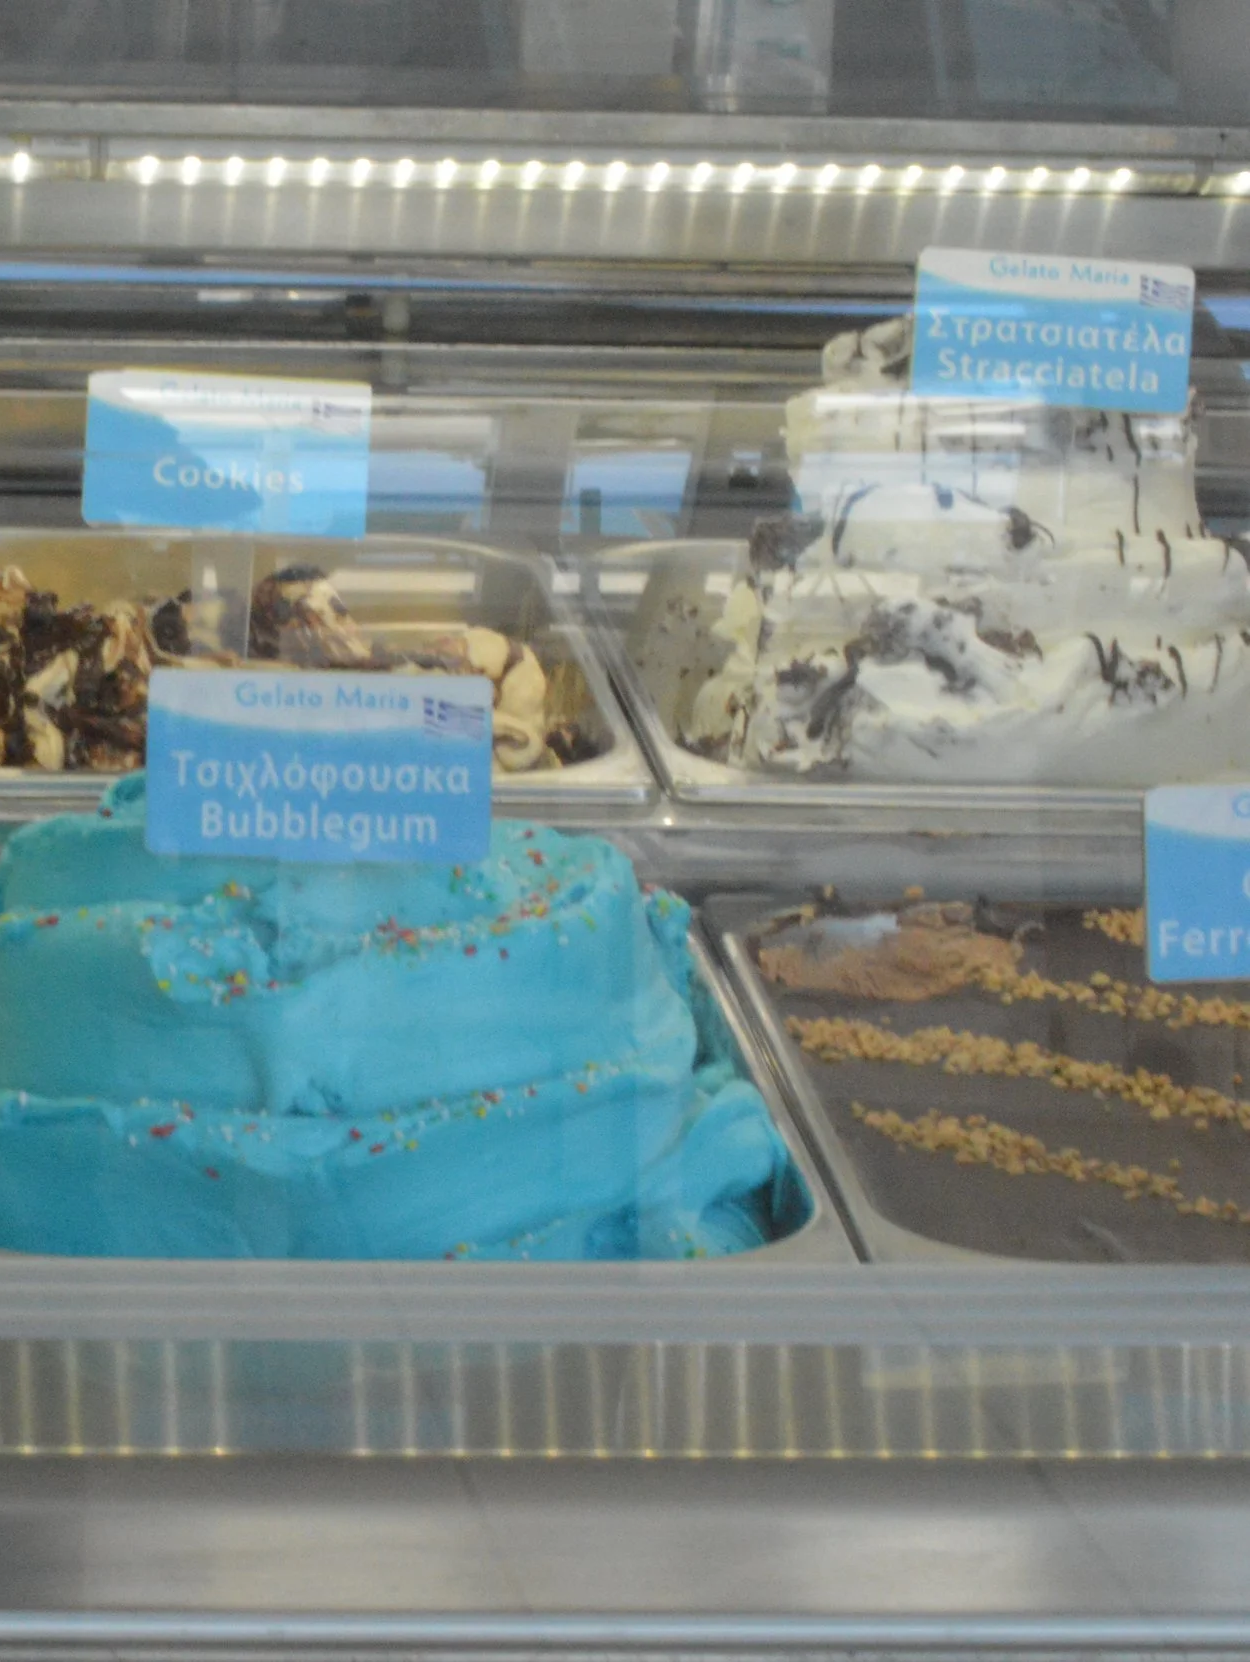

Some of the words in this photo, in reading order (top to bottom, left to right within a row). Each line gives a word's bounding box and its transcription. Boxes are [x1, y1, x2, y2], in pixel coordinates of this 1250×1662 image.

[989, 256, 1061, 281] Gelato
[1069, 265, 1131, 286] Maria
[927, 308, 1187, 356] Στρατσιατέλα
[937, 349, 1160, 394] Stracciatela
[152, 456, 305, 494] Cookies
[234, 682, 323, 710] Gelato
[336, 686, 411, 711] Maria
[169, 750, 472, 799] Τσιχλόφουσκα
[200, 800, 439, 850] Bubblegum
[1158, 918, 1250, 959] Ferr
